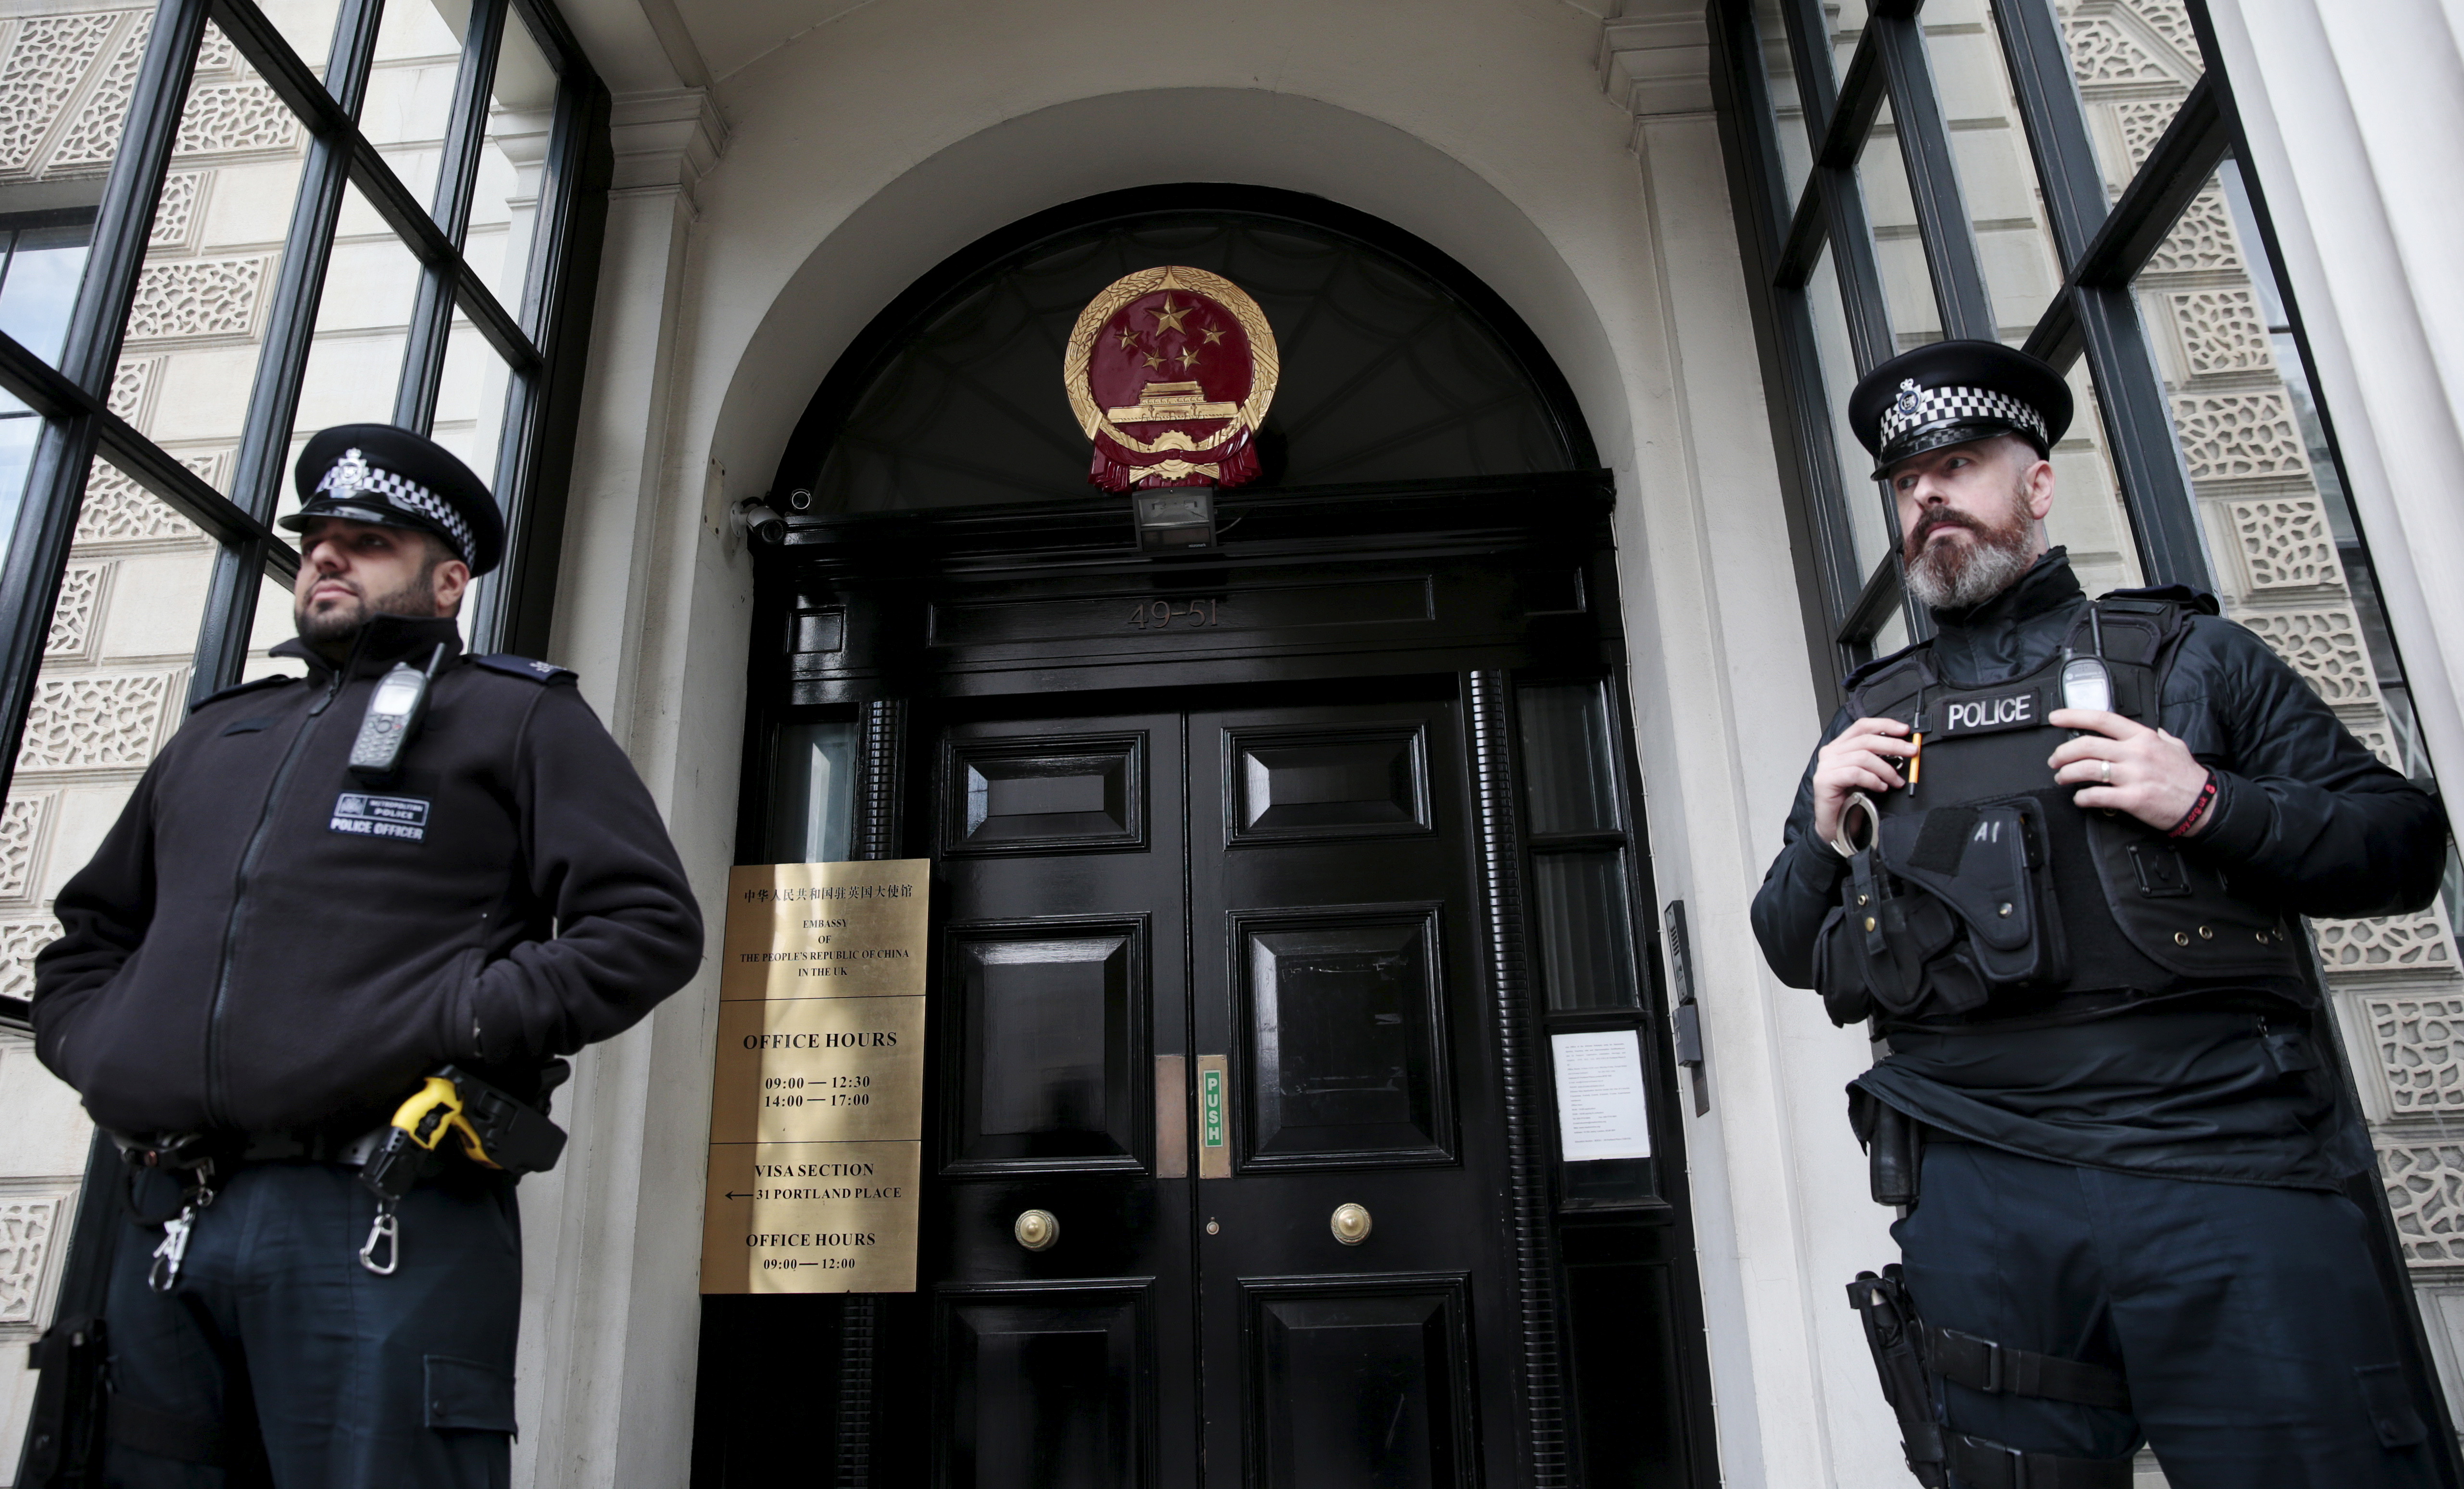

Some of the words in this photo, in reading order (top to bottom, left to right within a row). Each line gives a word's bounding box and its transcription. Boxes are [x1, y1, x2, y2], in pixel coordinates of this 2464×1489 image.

[1128, 598, 1218, 630] 49-51
[1948, 695, 2031, 730] POLICE
[374, 808, 414, 820] POLICE
[330, 818, 373, 833] POLICE
[374, 822, 424, 840] OFFICER
[744, 883, 913, 903] 中华人民共和国驻英国大使馆
[803, 919, 848, 929] EMBASSY
[818, 935, 831, 944] OF
[740, 953, 760, 962] THE
[762, 952, 807, 961] PEOPLE'S
[810, 950, 859, 960] REPUBLIC
[862, 950, 877, 959] OF
[877, 949, 909, 959] CHINA
[798, 968, 808, 977] IN
[811, 967, 831, 976] THE
[833, 967, 848, 976] UK
[743, 1034, 819, 1049] OFFICE
[825, 1032, 897, 1047] HOURS
[1207, 1077, 1219, 1140] PUSH
[754, 1165, 794, 1177] VISA
[798, 1163, 875, 1177] SECTION
[756, 1189, 769, 1199] 31
[773, 1188, 851, 1199] PORTLAND
[855, 1187, 902, 1199] PLACE
[746, 1234, 810, 1247] OFFICE
[816, 1233, 876, 1246] HOURS
